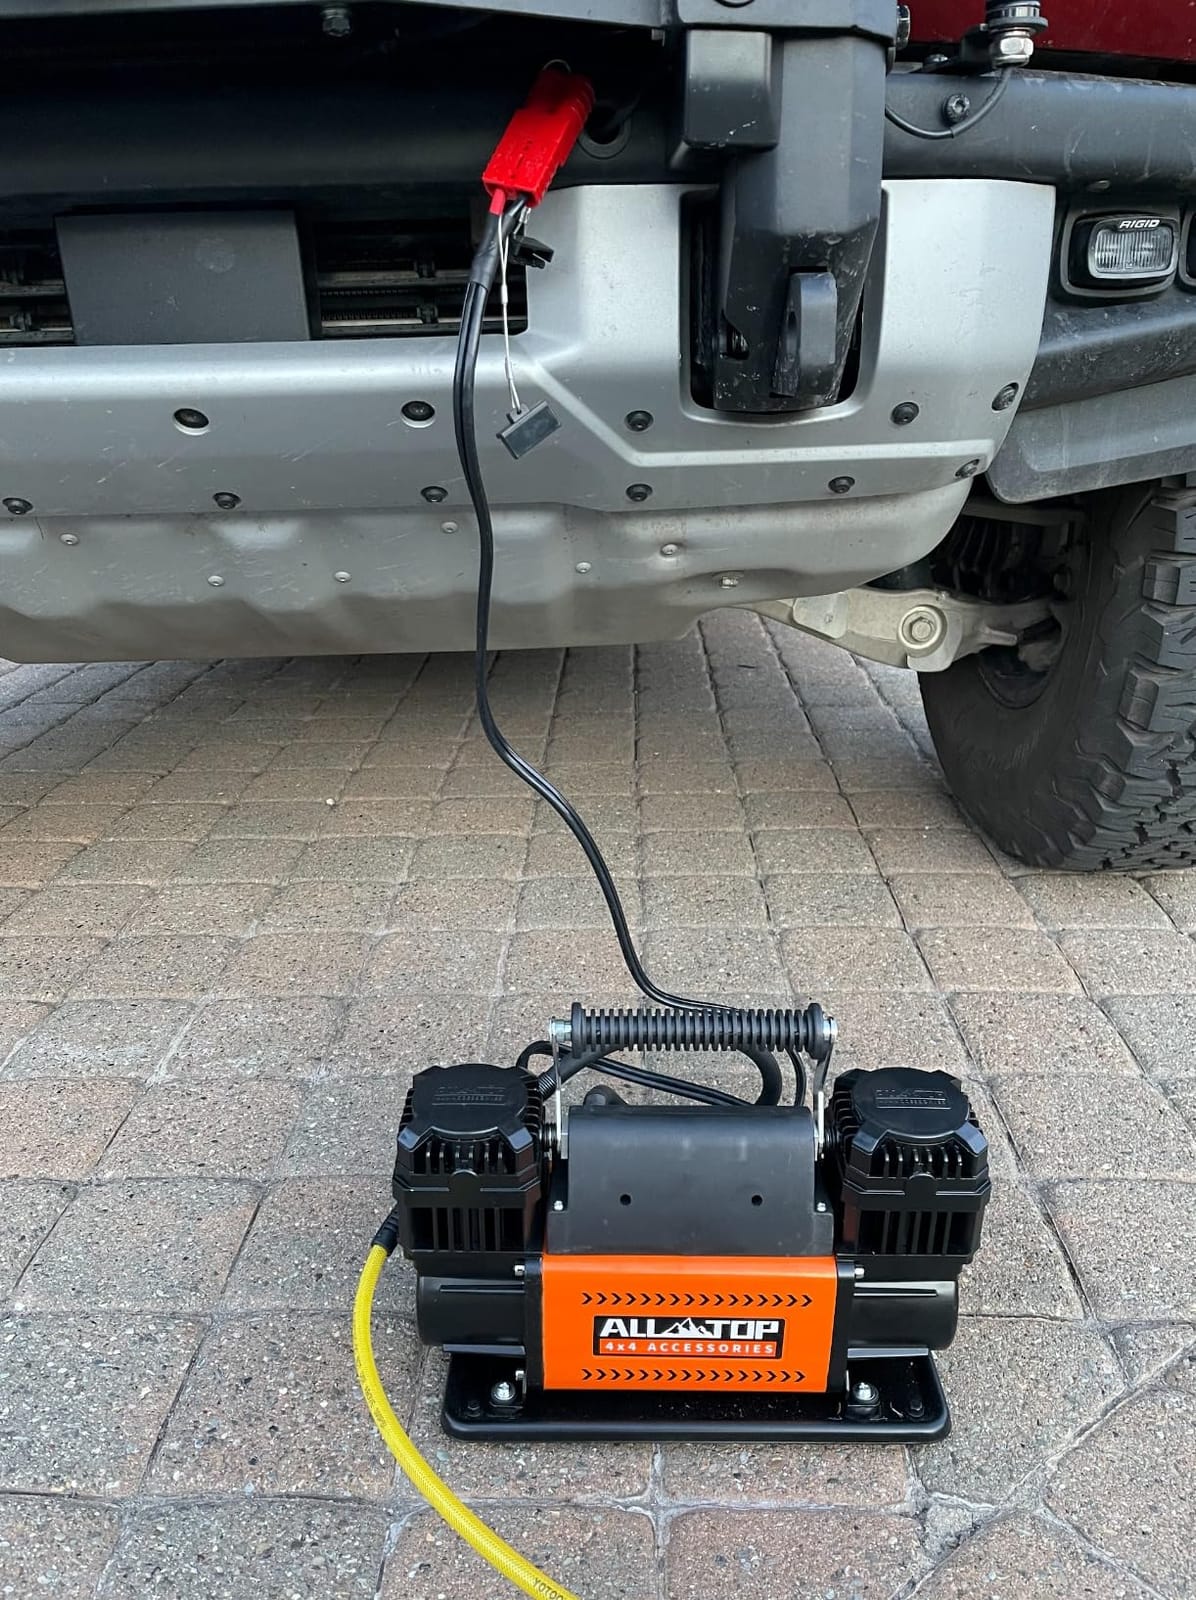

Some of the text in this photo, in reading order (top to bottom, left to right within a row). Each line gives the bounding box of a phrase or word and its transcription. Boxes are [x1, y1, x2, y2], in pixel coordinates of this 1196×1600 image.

[1119, 219, 1160, 229] RIGID
[605, 1341, 774, 1354] 4x4 ACCESSORIES
